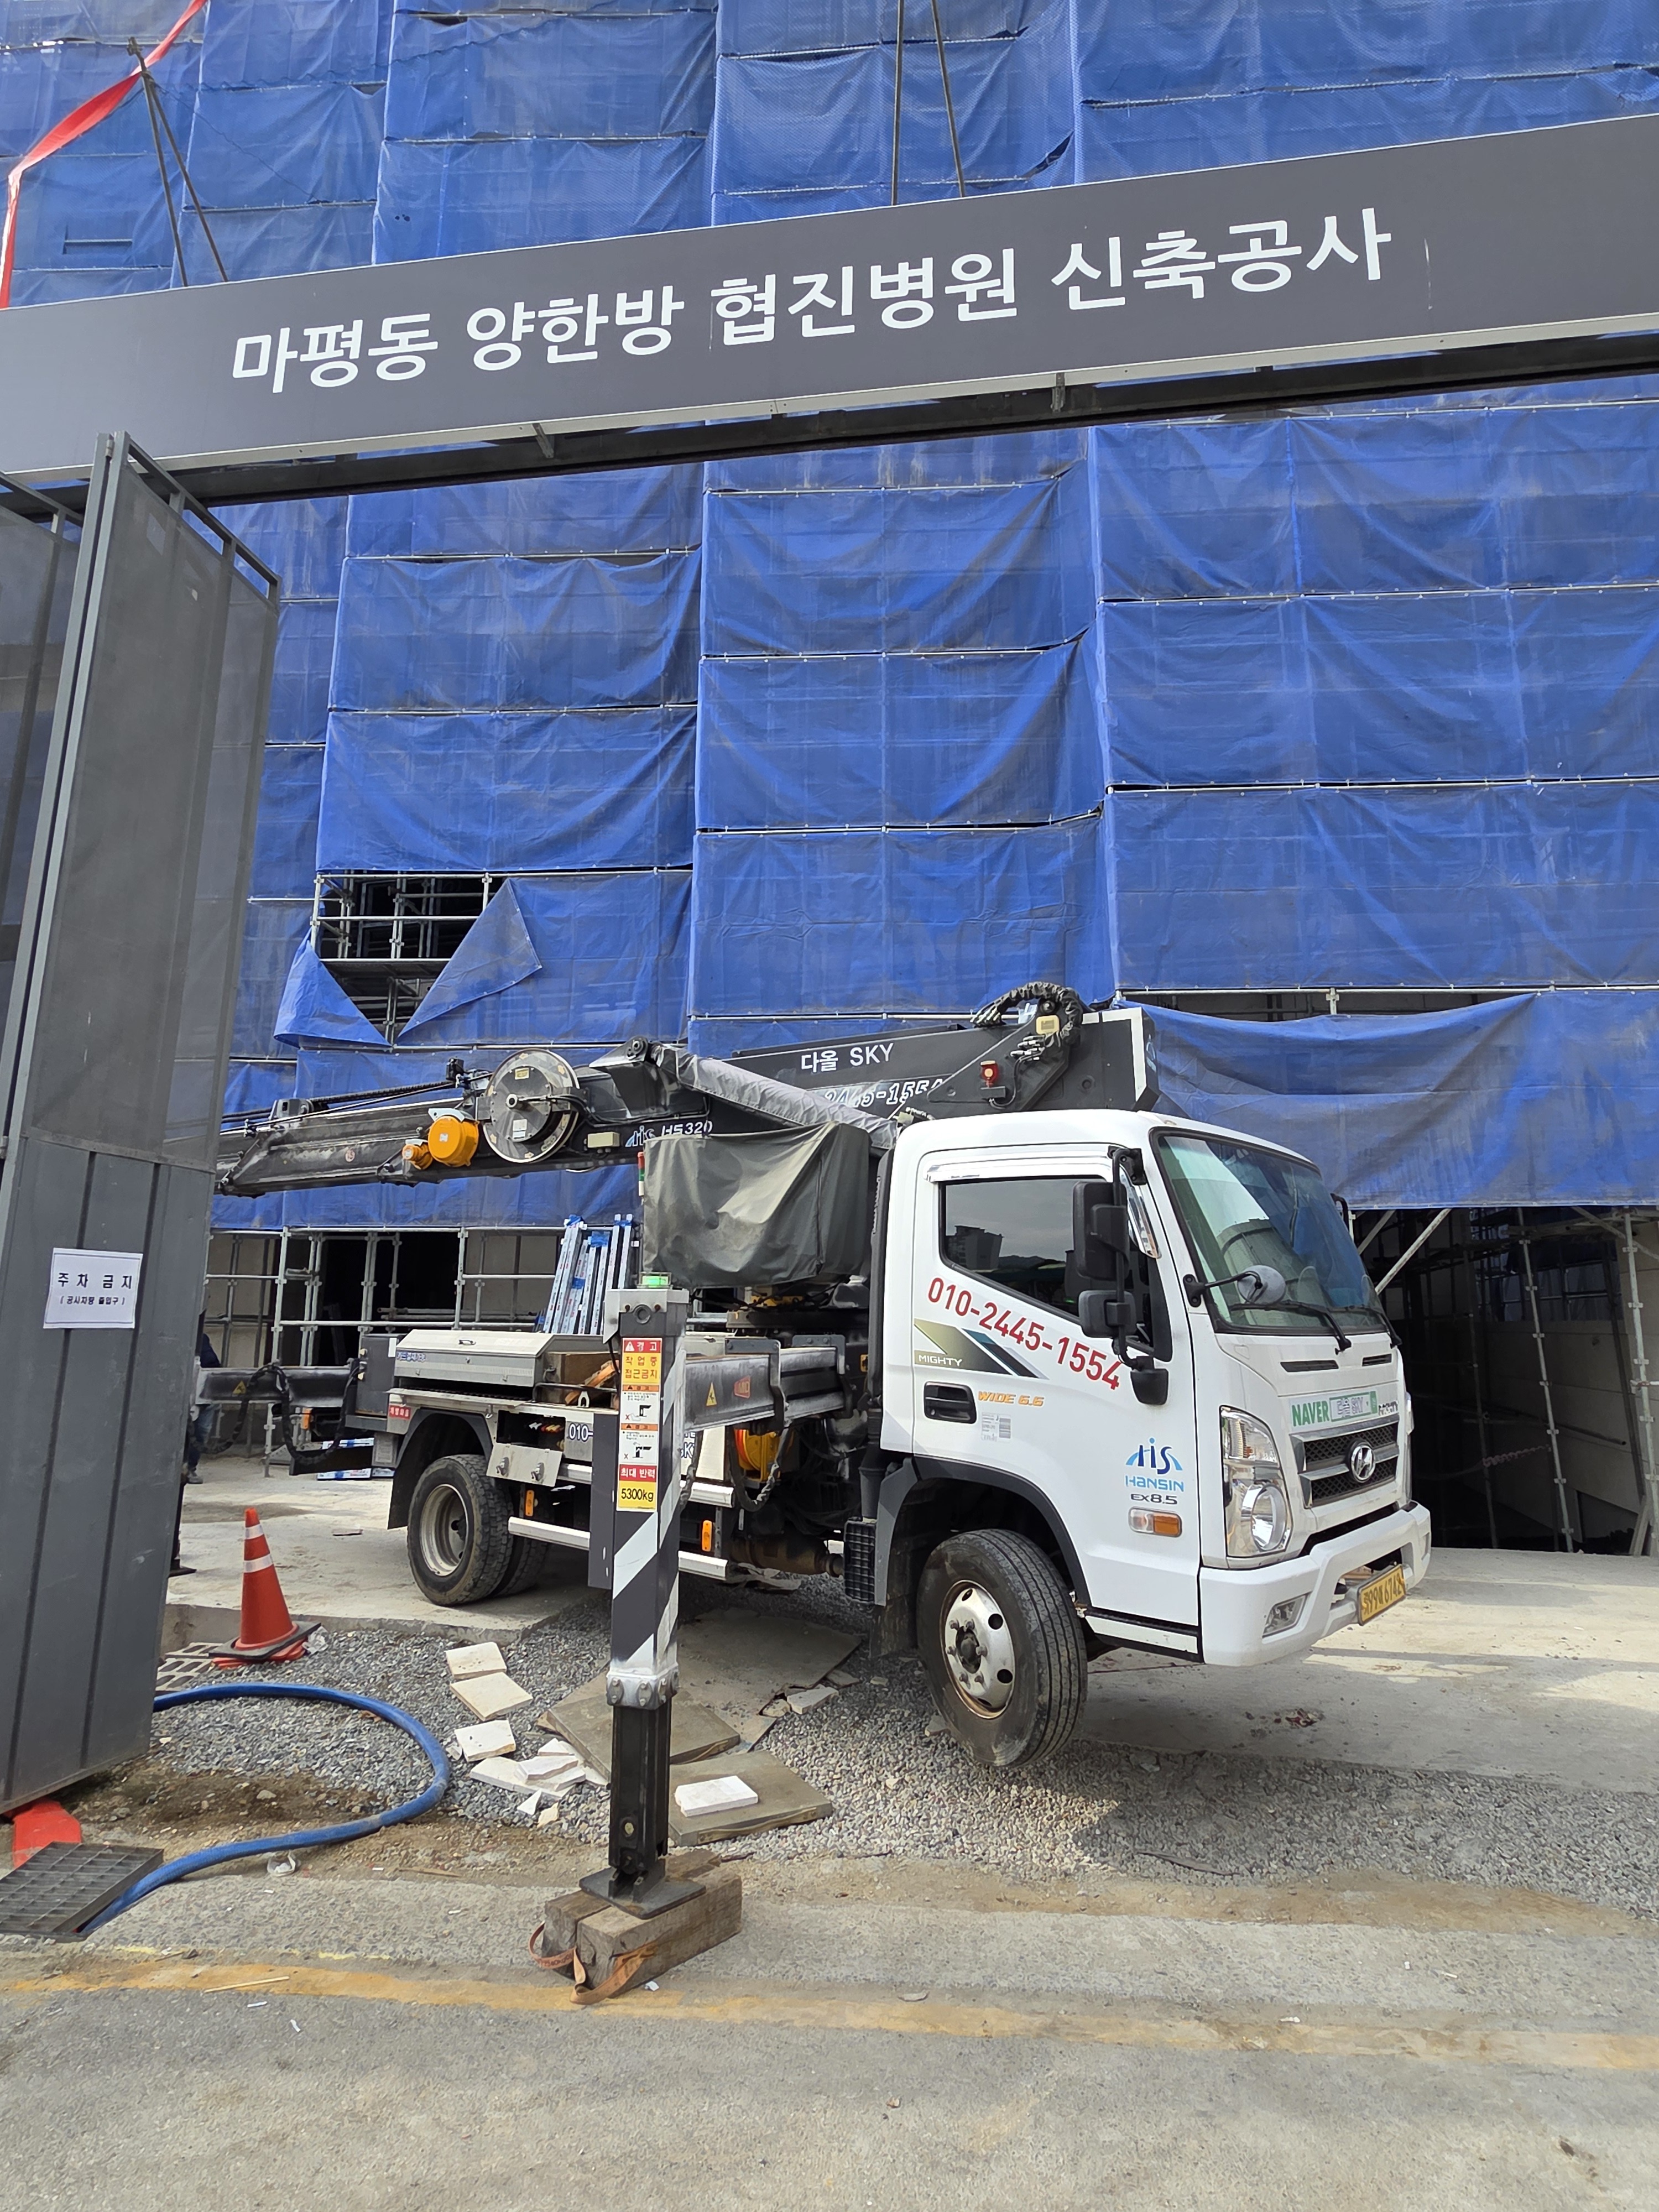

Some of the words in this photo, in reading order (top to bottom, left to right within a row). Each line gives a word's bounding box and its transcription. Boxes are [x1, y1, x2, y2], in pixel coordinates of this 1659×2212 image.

[232, 313, 439, 394] 마평동
[467, 285, 685, 371] 양한방
[711, 248, 1018, 346] 협진병원
[1051, 207, 1391, 310] 신축공사
[801, 1050, 838, 1073] 다올
[850, 1043, 894, 1066] SKY
[928, 1277, 1123, 1390] 010-2445-1554
[918, 1354, 963, 1367] MIGHTY
[625, 1369, 658, 1379] 접근금지
[978, 1391, 1016, 1404] WIDE
[1018, 1395, 1045, 1407] 6.6
[1291, 1400, 1329, 1427] NAVER
[620, 1467, 637, 1478] 최대
[620, 1488, 654, 1503] 5300kg
